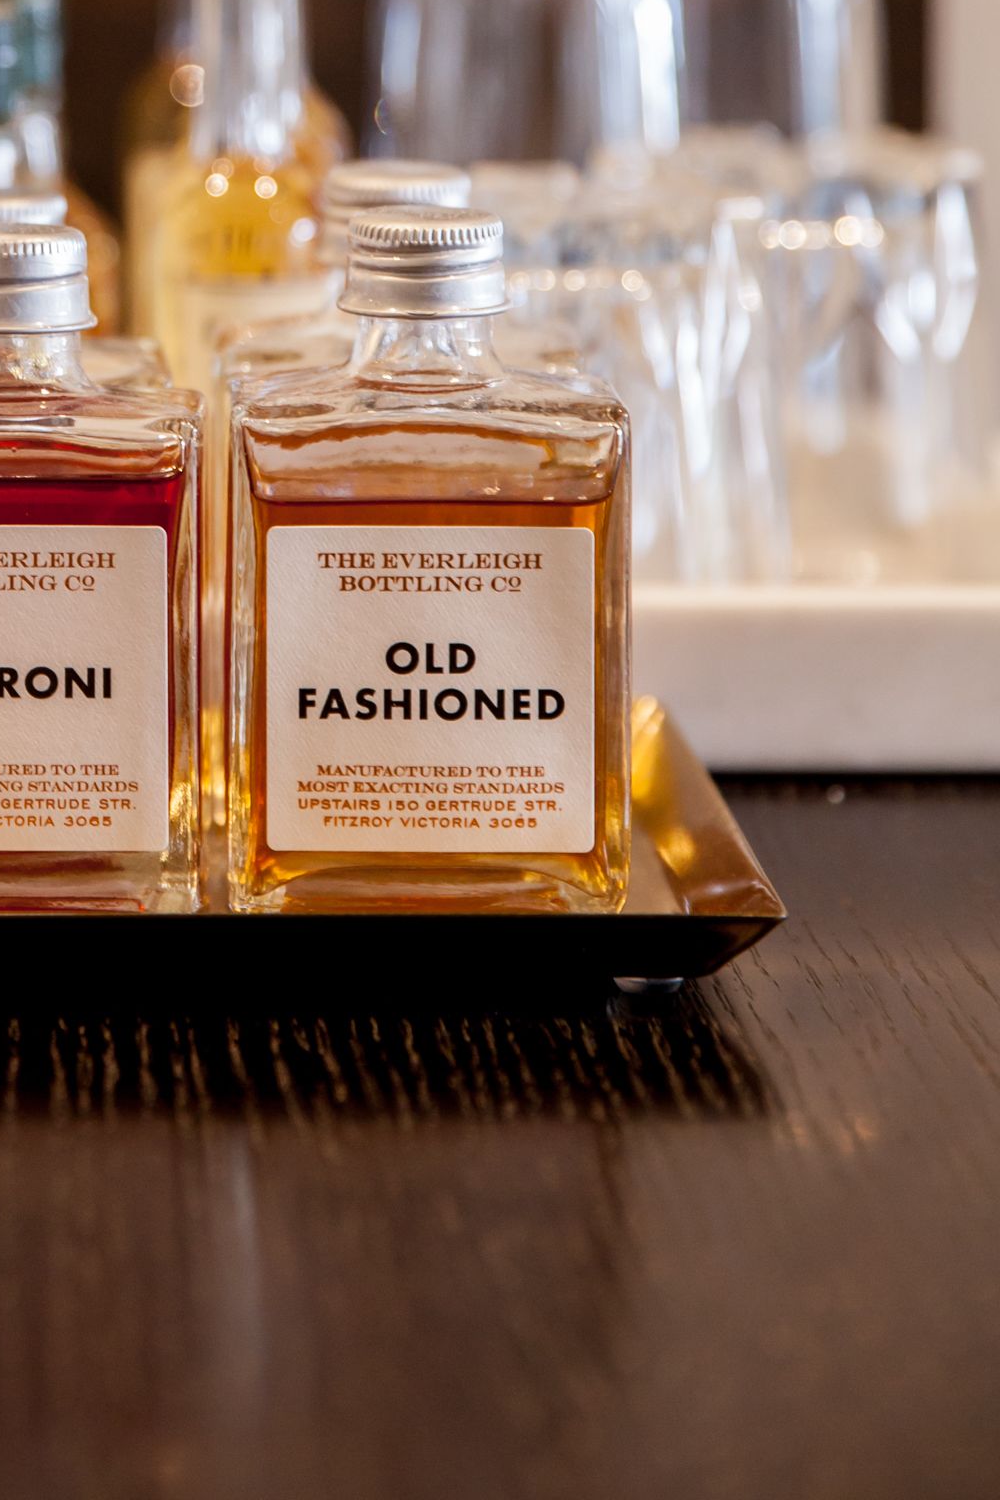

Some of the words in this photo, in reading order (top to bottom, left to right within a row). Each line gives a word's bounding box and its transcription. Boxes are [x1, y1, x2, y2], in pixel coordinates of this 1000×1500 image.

[317, 552, 375, 570] THE
[381, 552, 542, 570] EVERLEIGH
[339, 575, 484, 593] BOTTLING
[385, 642, 476, 675] OLD
[298, 688, 565, 721] FASHIONED
[50, 762, 76, 776] TO
[80, 762, 119, 776] THE
[317, 764, 472, 778] MANUFACTURED
[476, 764, 502, 778] TO
[506, 764, 545, 778] THE
[28, 779, 139, 793] STANDARDS
[297, 780, 349, 795] MOST
[354, 780, 448, 795] EXACTING
[453, 780, 564, 795] STANDARDS
[1, 797, 90, 810] GERTRUDE
[99, 797, 136, 810] STR.
[298, 798, 381, 812] UPSTAIRS
[389, 798, 419, 812] 150
[426, 798, 516, 812] GERTRUDE
[525, 798, 562, 812] STR.
[64, 814, 112, 828] 3065
[323, 815, 394, 829] FITZROY
[400, 815, 480, 829] VICTORIA
[488, 815, 537, 829] 3065
